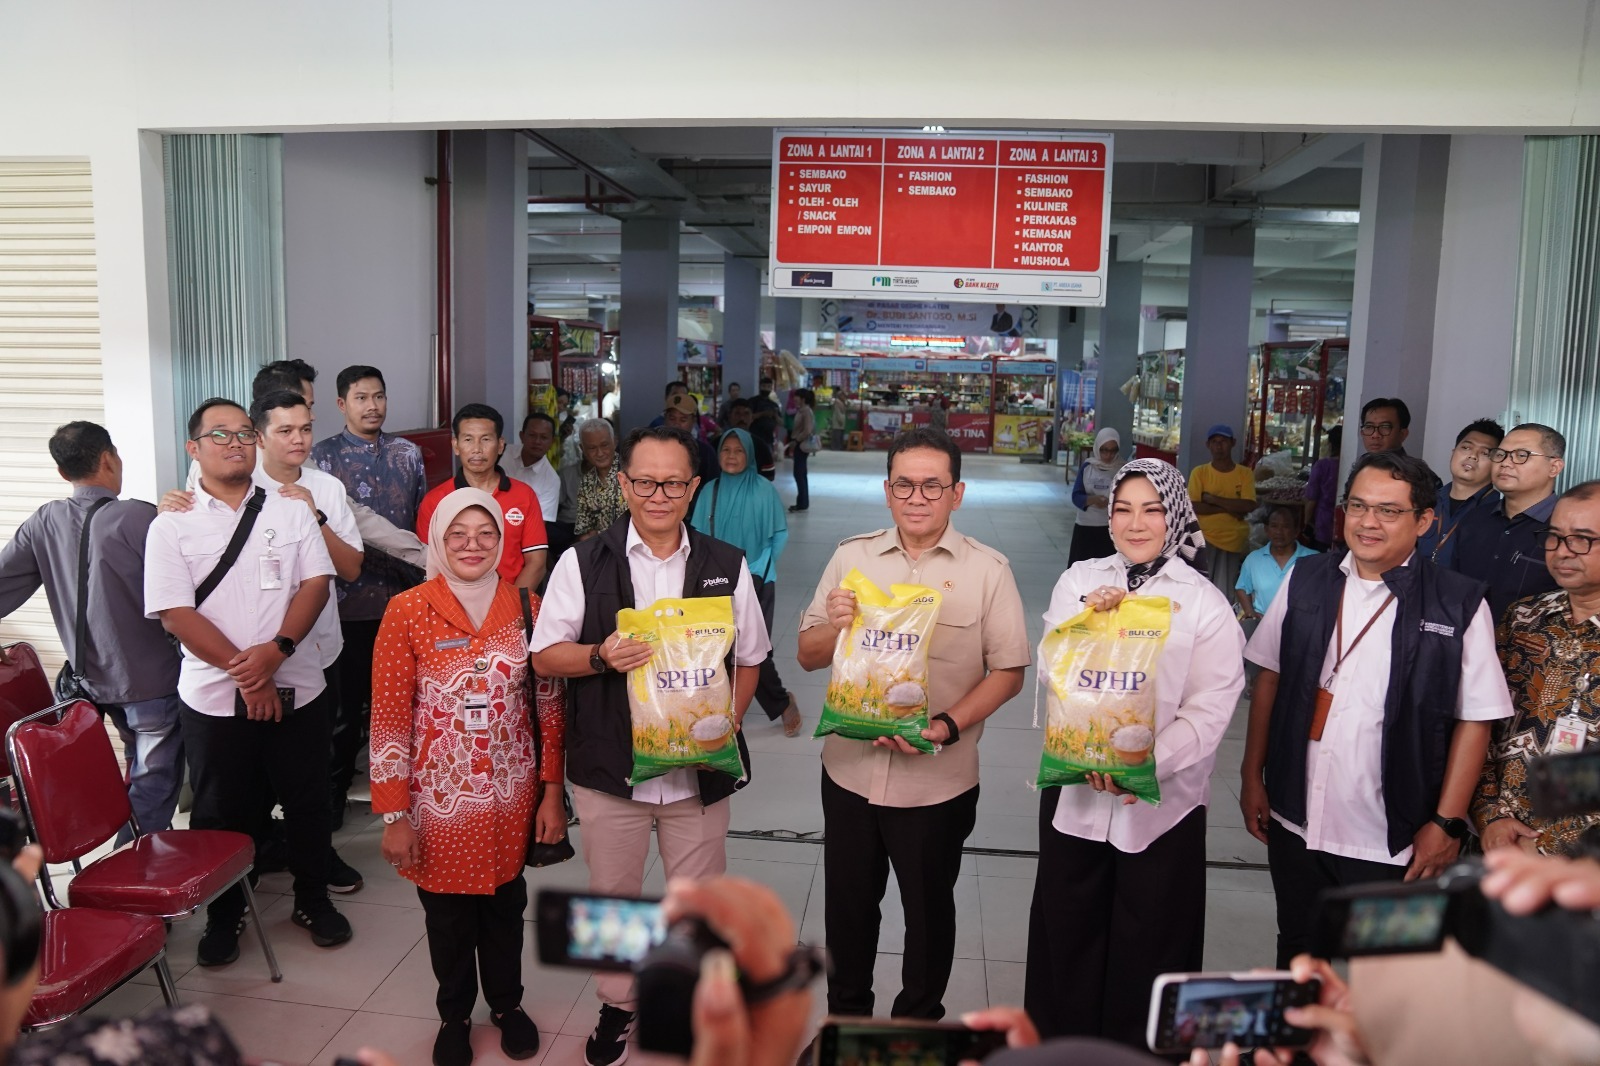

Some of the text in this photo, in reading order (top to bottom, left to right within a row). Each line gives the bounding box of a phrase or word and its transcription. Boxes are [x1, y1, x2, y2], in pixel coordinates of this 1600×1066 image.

[787, 144, 872, 158] ZONA A LANTAI 1
[897, 145, 985, 160] ZONA A LANTAI 2
[1009, 147, 1098, 163] ZONA A LANTAI 3
[799, 169, 847, 180] SEMBAKO
[908, 171, 952, 182] FASHION
[1024, 173, 1069, 184] FASHION
[798, 182, 832, 193] SAYUR
[908, 185, 957, 196] SEMBAKO
[1024, 187, 1073, 198] SEMBAKO
[798, 197, 825, 207] OLEH
[832, 197, 859, 208] OLEH
[1023, 201, 1068, 212] KULINER
[802, 211, 837, 221] SNACK
[1023, 214, 1077, 226] PERKAKAS
[797, 224, 872, 236] EMPON EMPON
[1022, 228, 1072, 239] KEMASAN
[1021, 242, 1064, 253] KANTOR
[1020, 255, 1071, 267] MUSHOLA
[882, 311, 905, 320] BUDI
[963, 429, 985, 438] TINA
[708, 577, 729, 586] bulog
[695, 627, 726, 635] BULOG
[861, 628, 920, 651] SPHP
[656, 668, 716, 689] SPHP
[1078, 669, 1147, 691] SPHP
[862, 702, 880, 716] 5 kg
[669, 742, 677, 753] 5
[1085, 747, 1094, 759] 5
